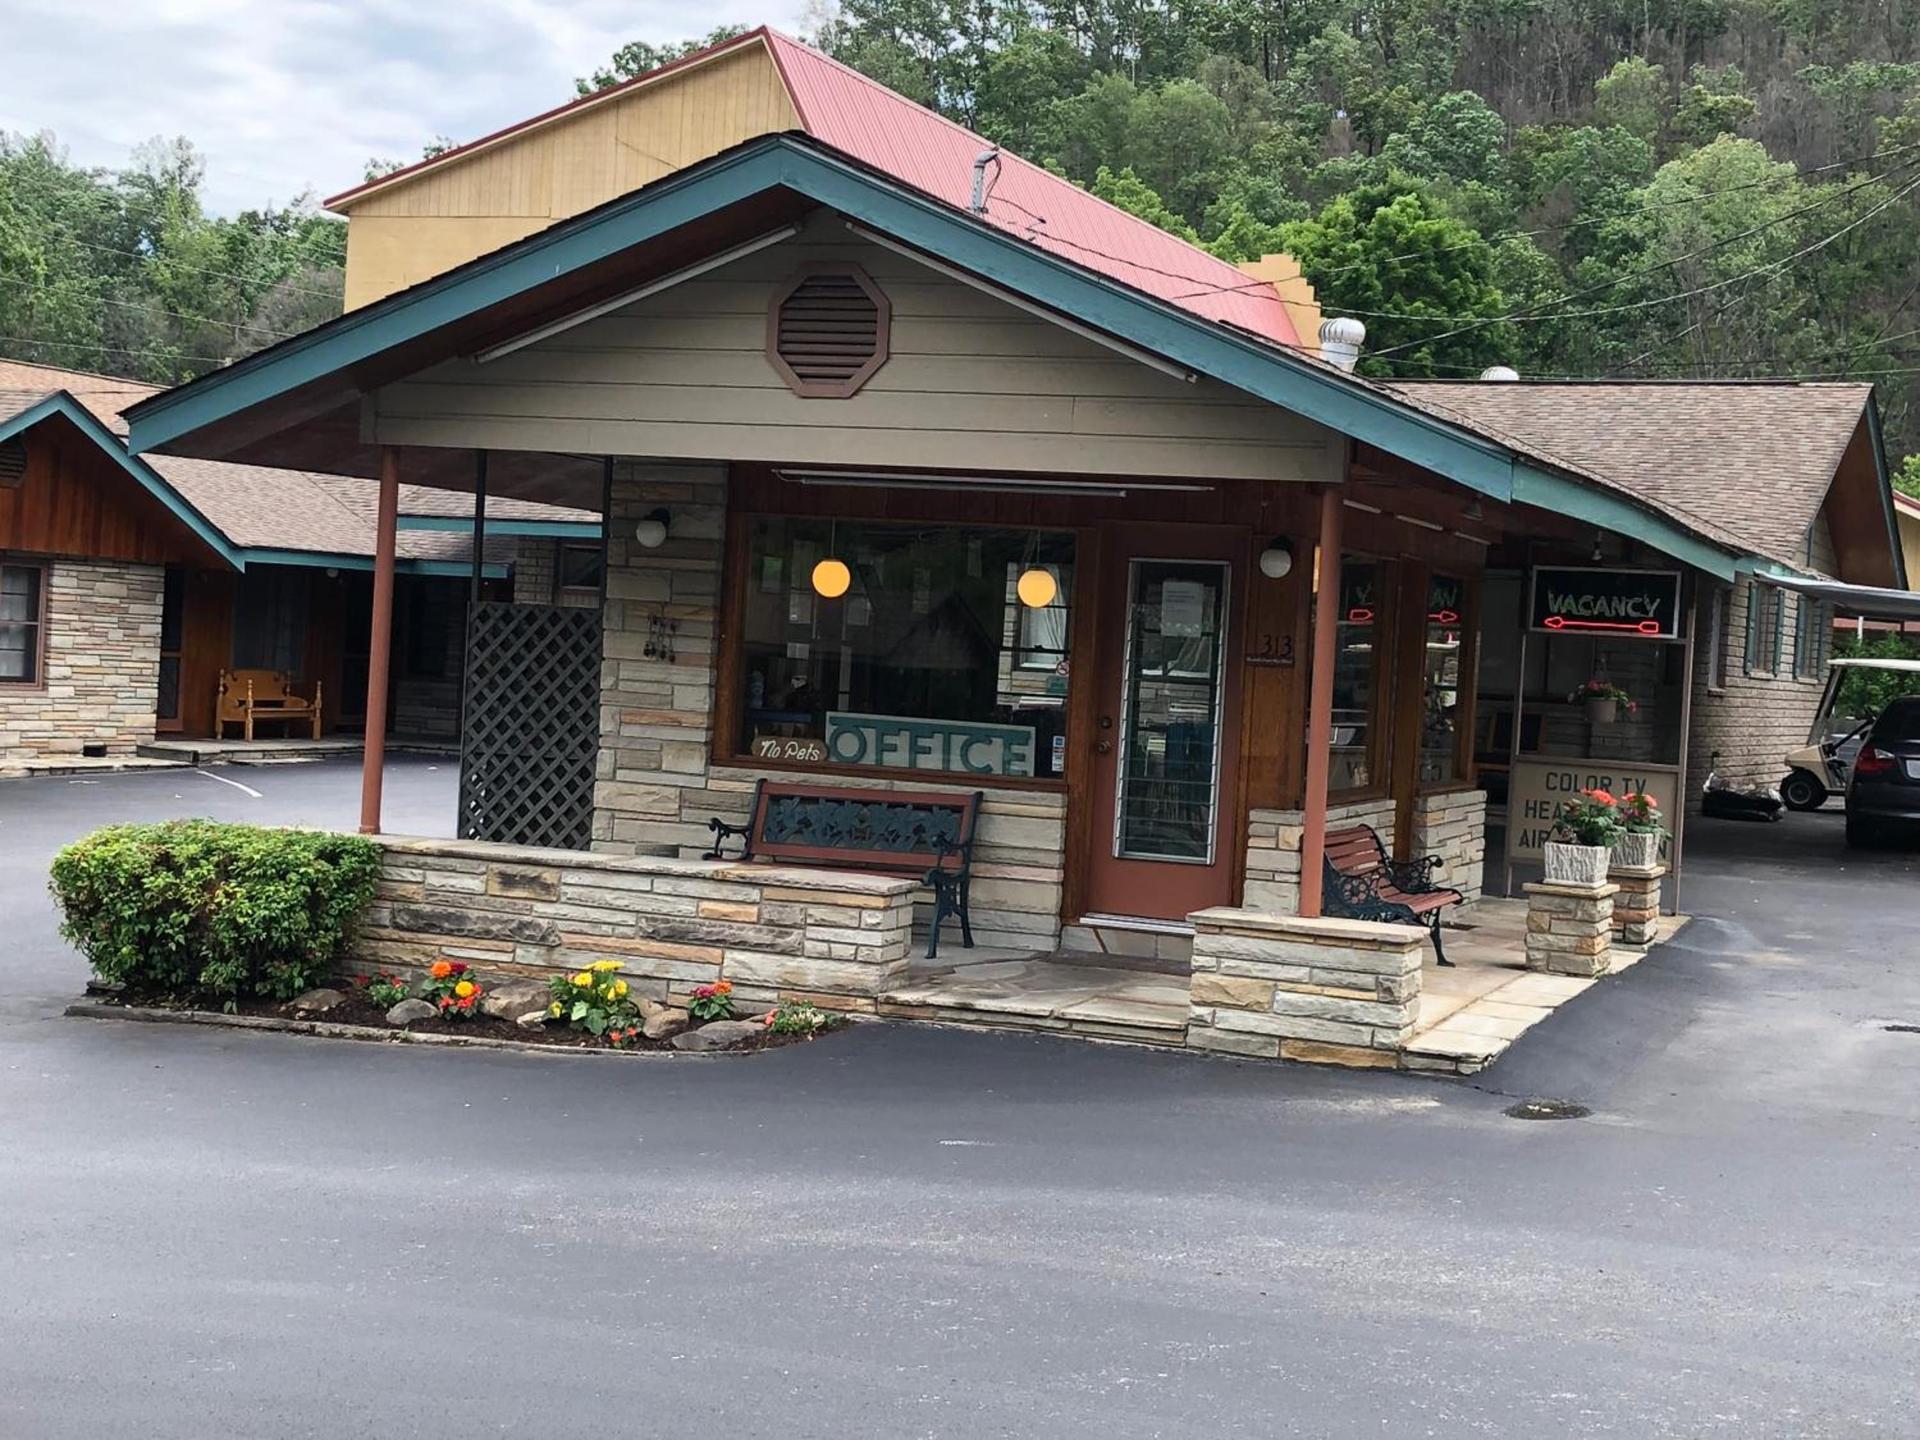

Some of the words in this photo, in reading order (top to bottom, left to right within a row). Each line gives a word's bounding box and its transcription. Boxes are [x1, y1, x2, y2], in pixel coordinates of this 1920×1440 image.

[1547, 589, 1661, 618] VACANCY
[1260, 633, 1292, 657] 313
[759, 739, 782, 759] No
[784, 740, 821, 762] Pets
[829, 717, 1034, 776] OFFICE
[1546, 772, 1612, 793] COLOR
[1622, 777, 1646, 794] TV
[1525, 799, 1564, 820] HEA
